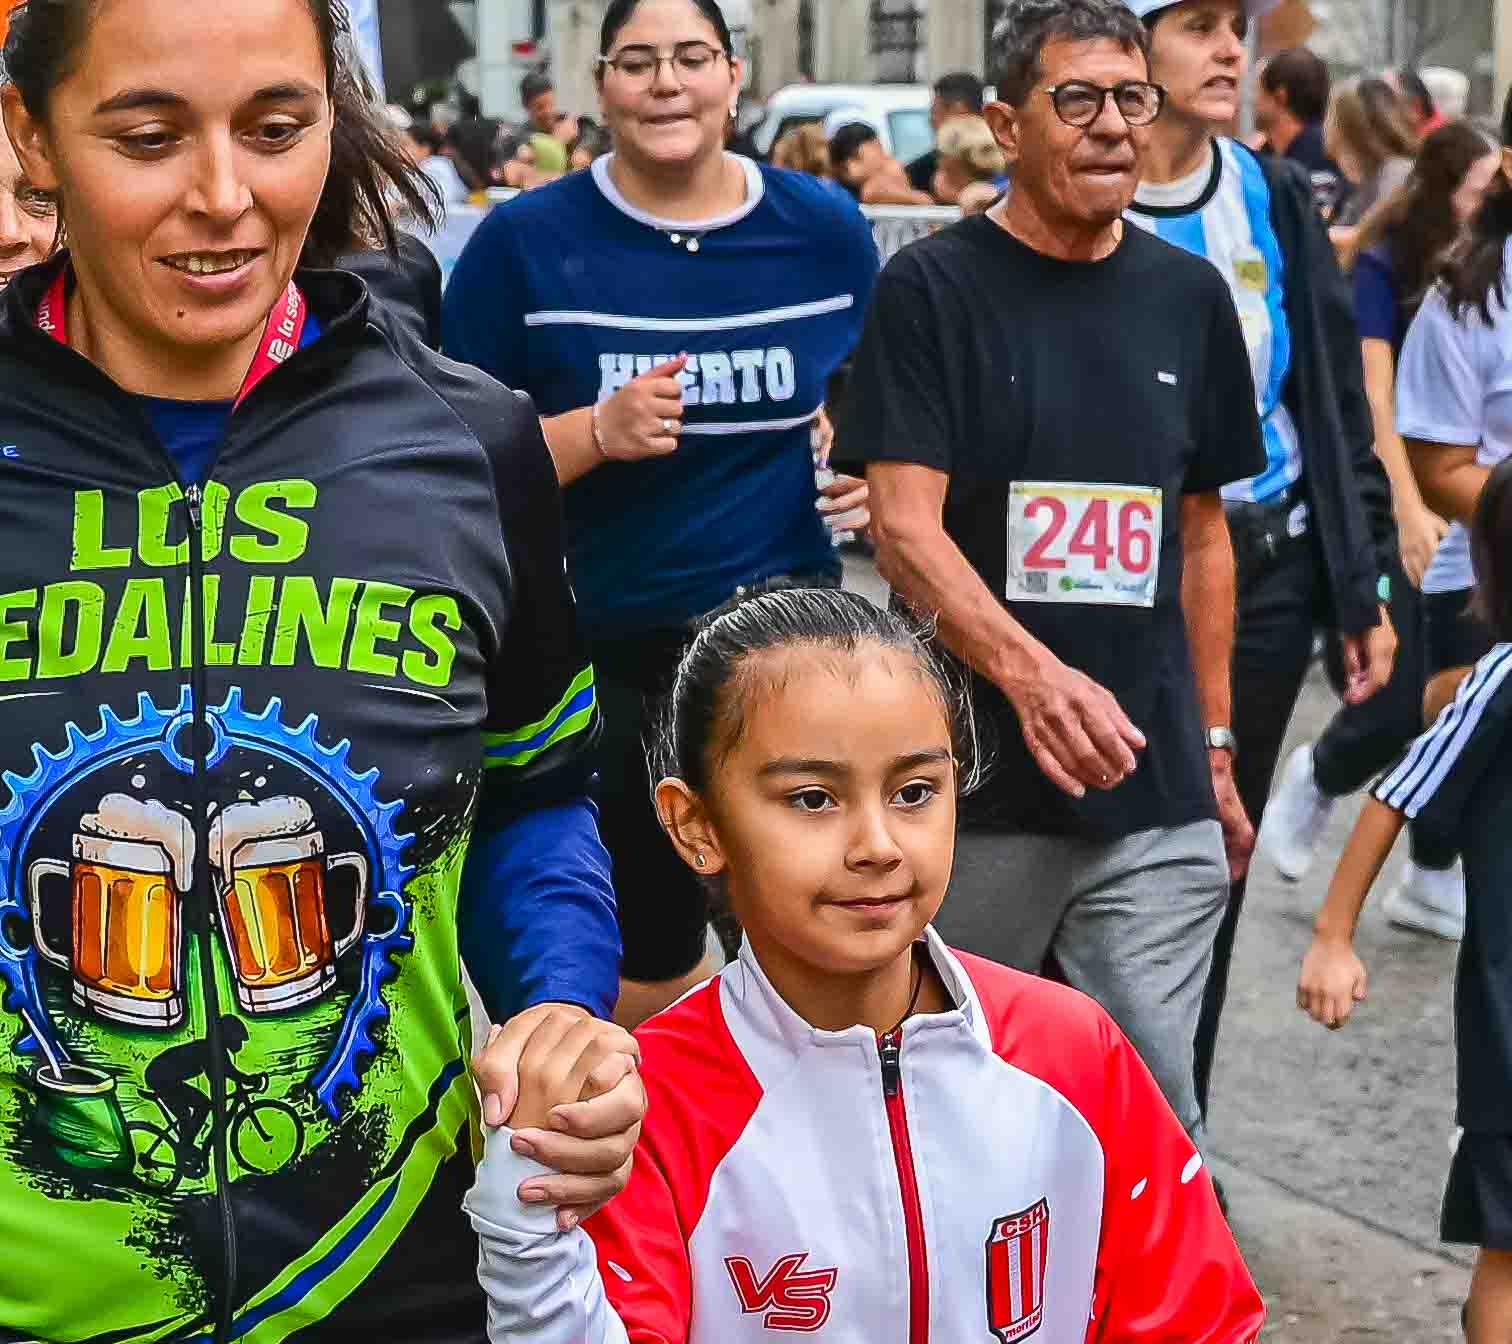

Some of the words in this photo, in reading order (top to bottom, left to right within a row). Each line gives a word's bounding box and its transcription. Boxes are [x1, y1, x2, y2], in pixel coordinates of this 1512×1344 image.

[71, 480, 320, 571] LOS
[1023, 495, 1153, 574] 246
[1000, 1206, 1044, 1239] CSH
